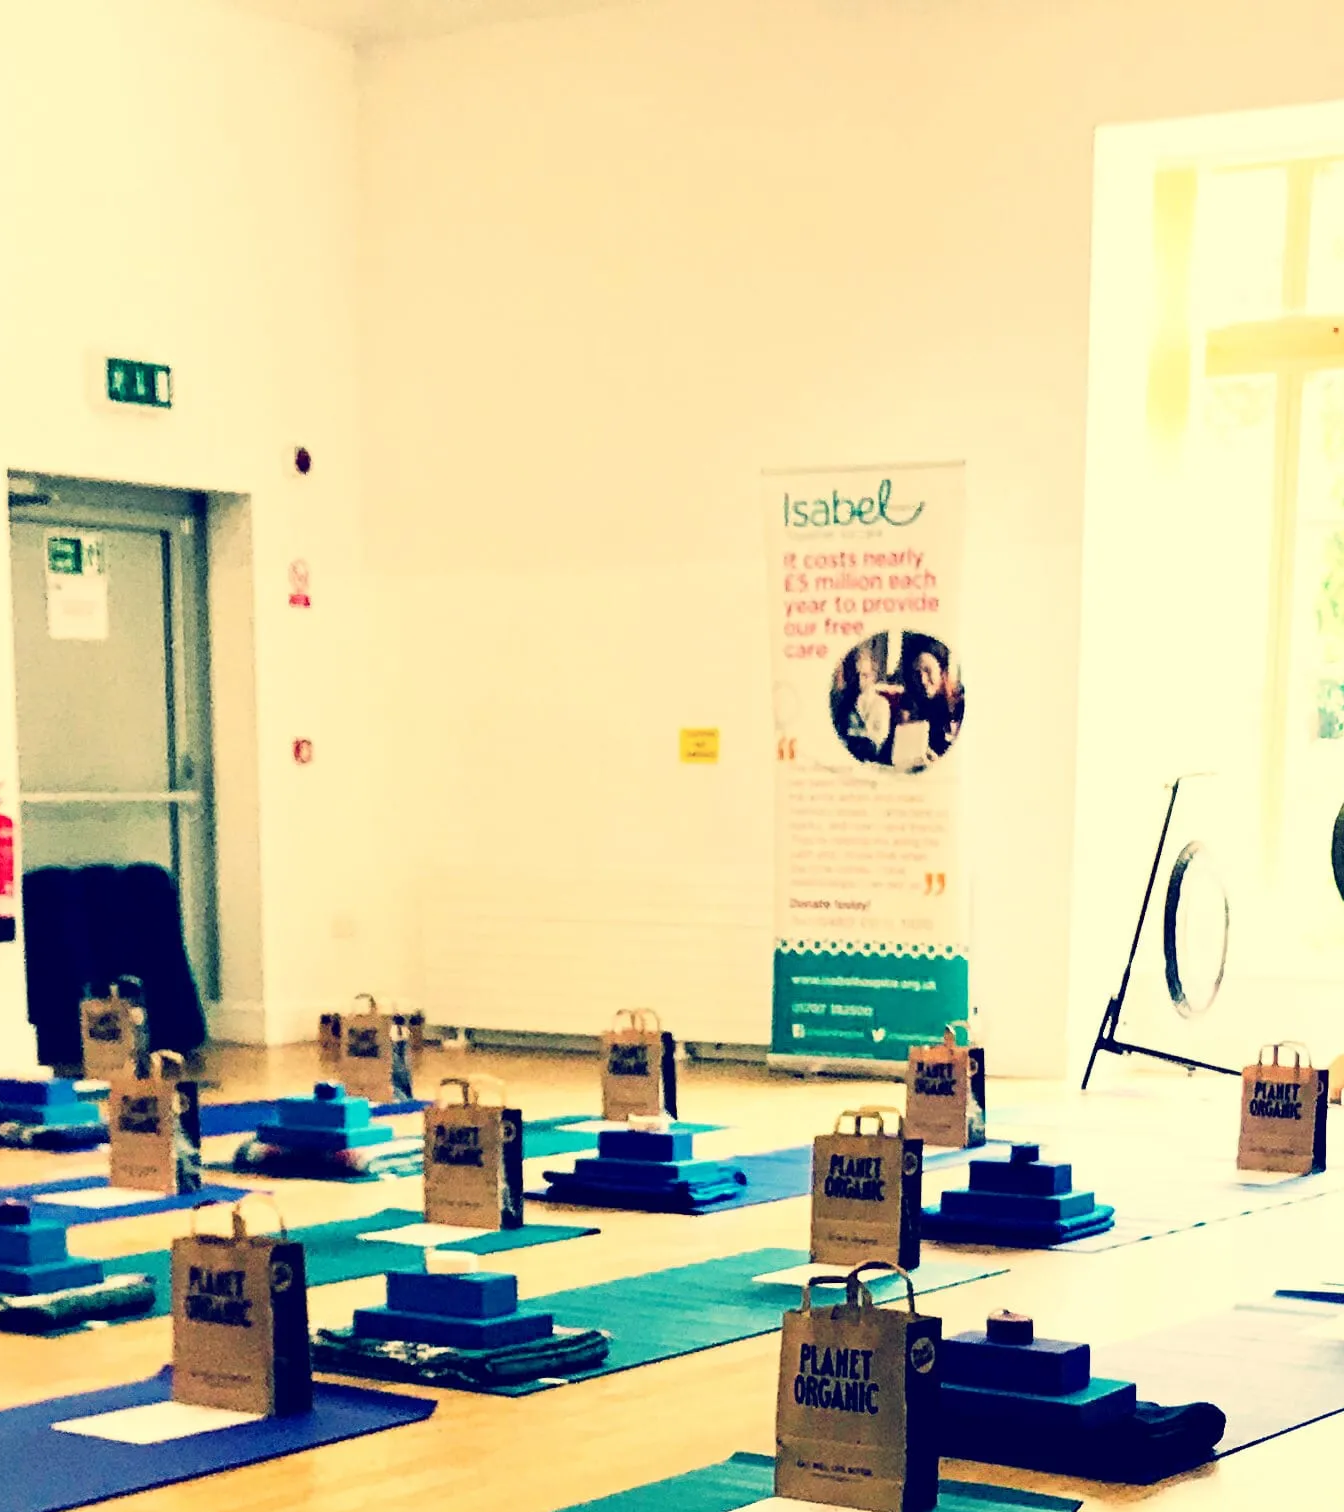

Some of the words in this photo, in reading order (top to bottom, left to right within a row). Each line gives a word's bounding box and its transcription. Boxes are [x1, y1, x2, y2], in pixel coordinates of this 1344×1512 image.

[784, 478, 925, 527] Isabel
[803, 552, 856, 569] costs
[863, 548, 924, 570] nearly
[784, 573, 809, 593] £5
[815, 573, 883, 591] million
[888, 569, 937, 590] each
[783, 599, 828, 618] year
[835, 597, 857, 614] to
[863, 593, 940, 614] provide
[783, 622, 817, 637] our
[824, 618, 864, 636] free
[783, 644, 829, 659] care
[1254, 1081, 1301, 1101] PLANET
[1249, 1099, 1302, 1120] ORGANIC
[800, 1343, 873, 1381] PLANET
[794, 1374, 879, 1415] ORGANIC
